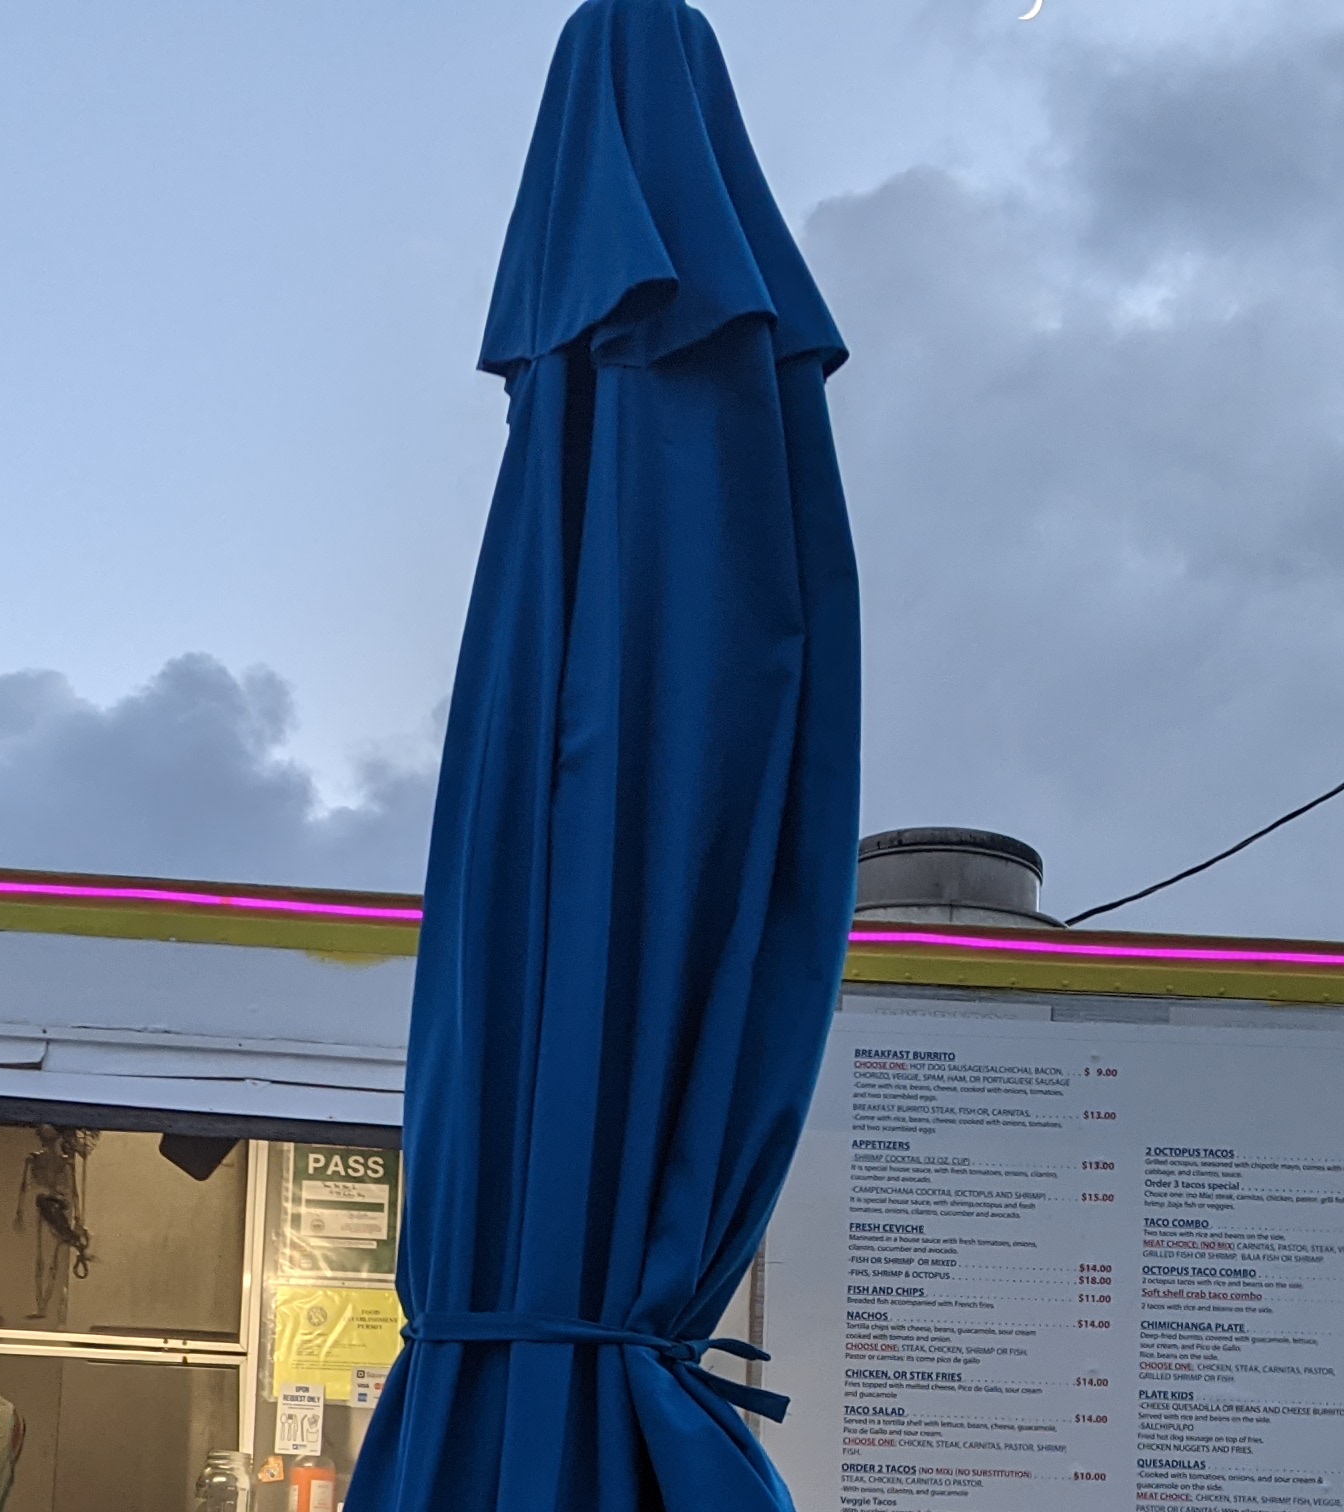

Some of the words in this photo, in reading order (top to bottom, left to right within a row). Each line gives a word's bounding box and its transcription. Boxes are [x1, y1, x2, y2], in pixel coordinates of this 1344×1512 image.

[855, 1049, 910, 1060] BREAKFAST
[913, 1050, 956, 1061] BURRITO
[1096, 1068, 1117, 1078] 9.00
[1083, 1110, 1116, 1121] $13.00
[851, 1140, 910, 1150] APPETIZERS
[1146, 1147, 1152, 1156] 2
[1154, 1148, 1201, 1158] OCTOPUS
[1202, 1149, 1234, 1158] TACOS
[307, 1153, 385, 1178] PASS
[1082, 1161, 1115, 1171] $13.00
[1081, 1193, 1114, 1202] $15.00
[849, 1223, 881, 1233] FRESH
[882, 1224, 924, 1235] CEVICHE
[1143, 1218, 1170, 1228] TACO
[1172, 1218, 1209, 1228] COMBO
[1078, 1264, 1112, 1274] $14.00
[1142, 1266, 1190, 1276] OCTOPUS
[1191, 1267, 1217, 1277] TACO
[1219, 1268, 1256, 1278] COMBO
[1078, 1276, 1112, 1286] $18.00
[847, 1285, 869, 1296] FISH
[872, 1286, 893, 1296] AND
[895, 1286, 925, 1297] CHIPS
[1078, 1294, 1111, 1304] $11.00
[846, 1311, 888, 1321] NACHOS
[1077, 1319, 1110, 1329] $14.00
[1140, 1320, 1213, 1332] CHIMICHANGA
[1215, 1322, 1245, 1333] PLATE
[845, 1370, 891, 1381] CHICKEN,
[893, 1371, 907, 1380] OR
[909, 1371, 933, 1381] STEK
[936, 1372, 962, 1382] FRIES
[1075, 1377, 1109, 1387] $14.00
[1139, 1390, 1169, 1400] PLATE
[1171, 1390, 1194, 1400] KIDS
[844, 1406, 870, 1416] TACO
[872, 1406, 905, 1417] SALAD
[1074, 1414, 1108, 1424] $14.00
[1136, 1458, 1206, 1470] QUESADILLAS
[841, 1463, 875, 1473] ORDER
[885, 1464, 916, 1474] TACOS
[1073, 1472, 1106, 1481] $10.00
